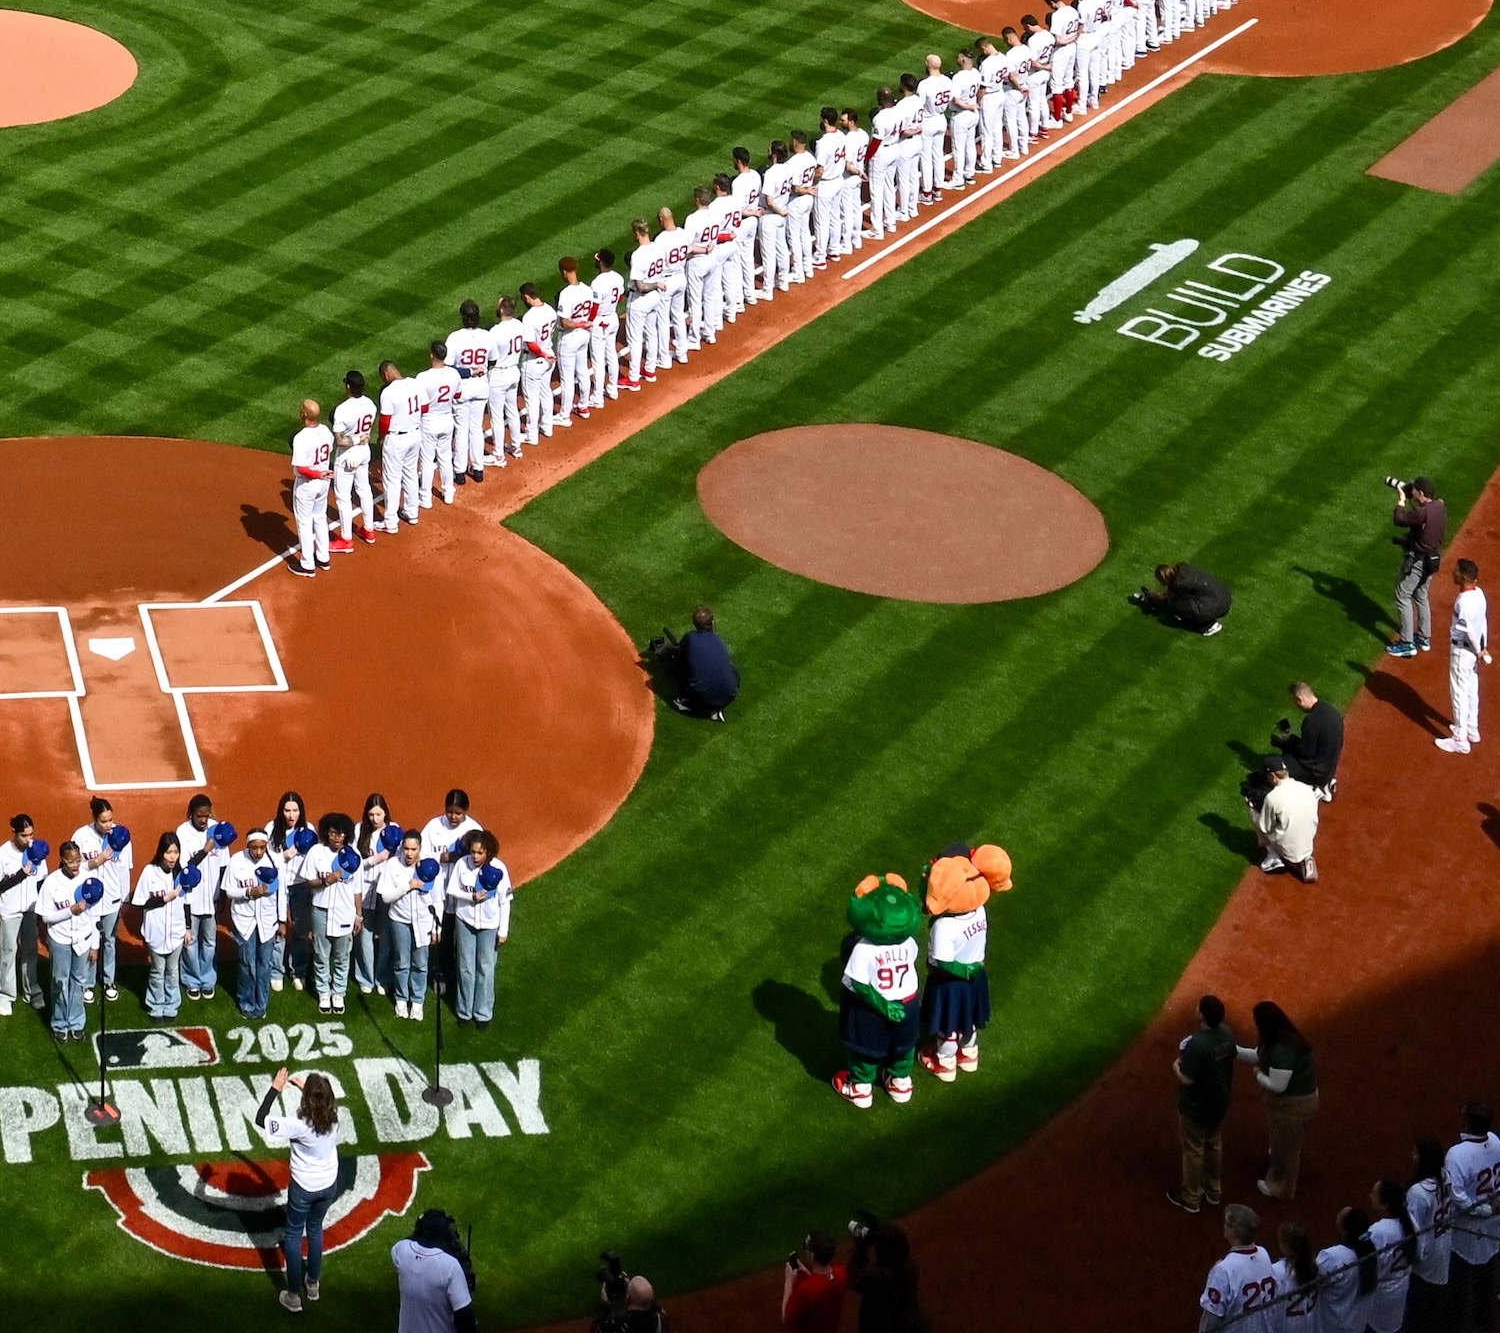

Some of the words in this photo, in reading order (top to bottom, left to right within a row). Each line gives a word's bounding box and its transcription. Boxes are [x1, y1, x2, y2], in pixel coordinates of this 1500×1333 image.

[1116, 252, 1285, 351] BUILD
[1197, 270, 1332, 362] SUBMARINES
[461, 348, 487, 365] 36
[877, 964, 910, 990] 97
[225, 1021, 354, 1064] 2025
[352, 1058, 550, 1143] DAY
